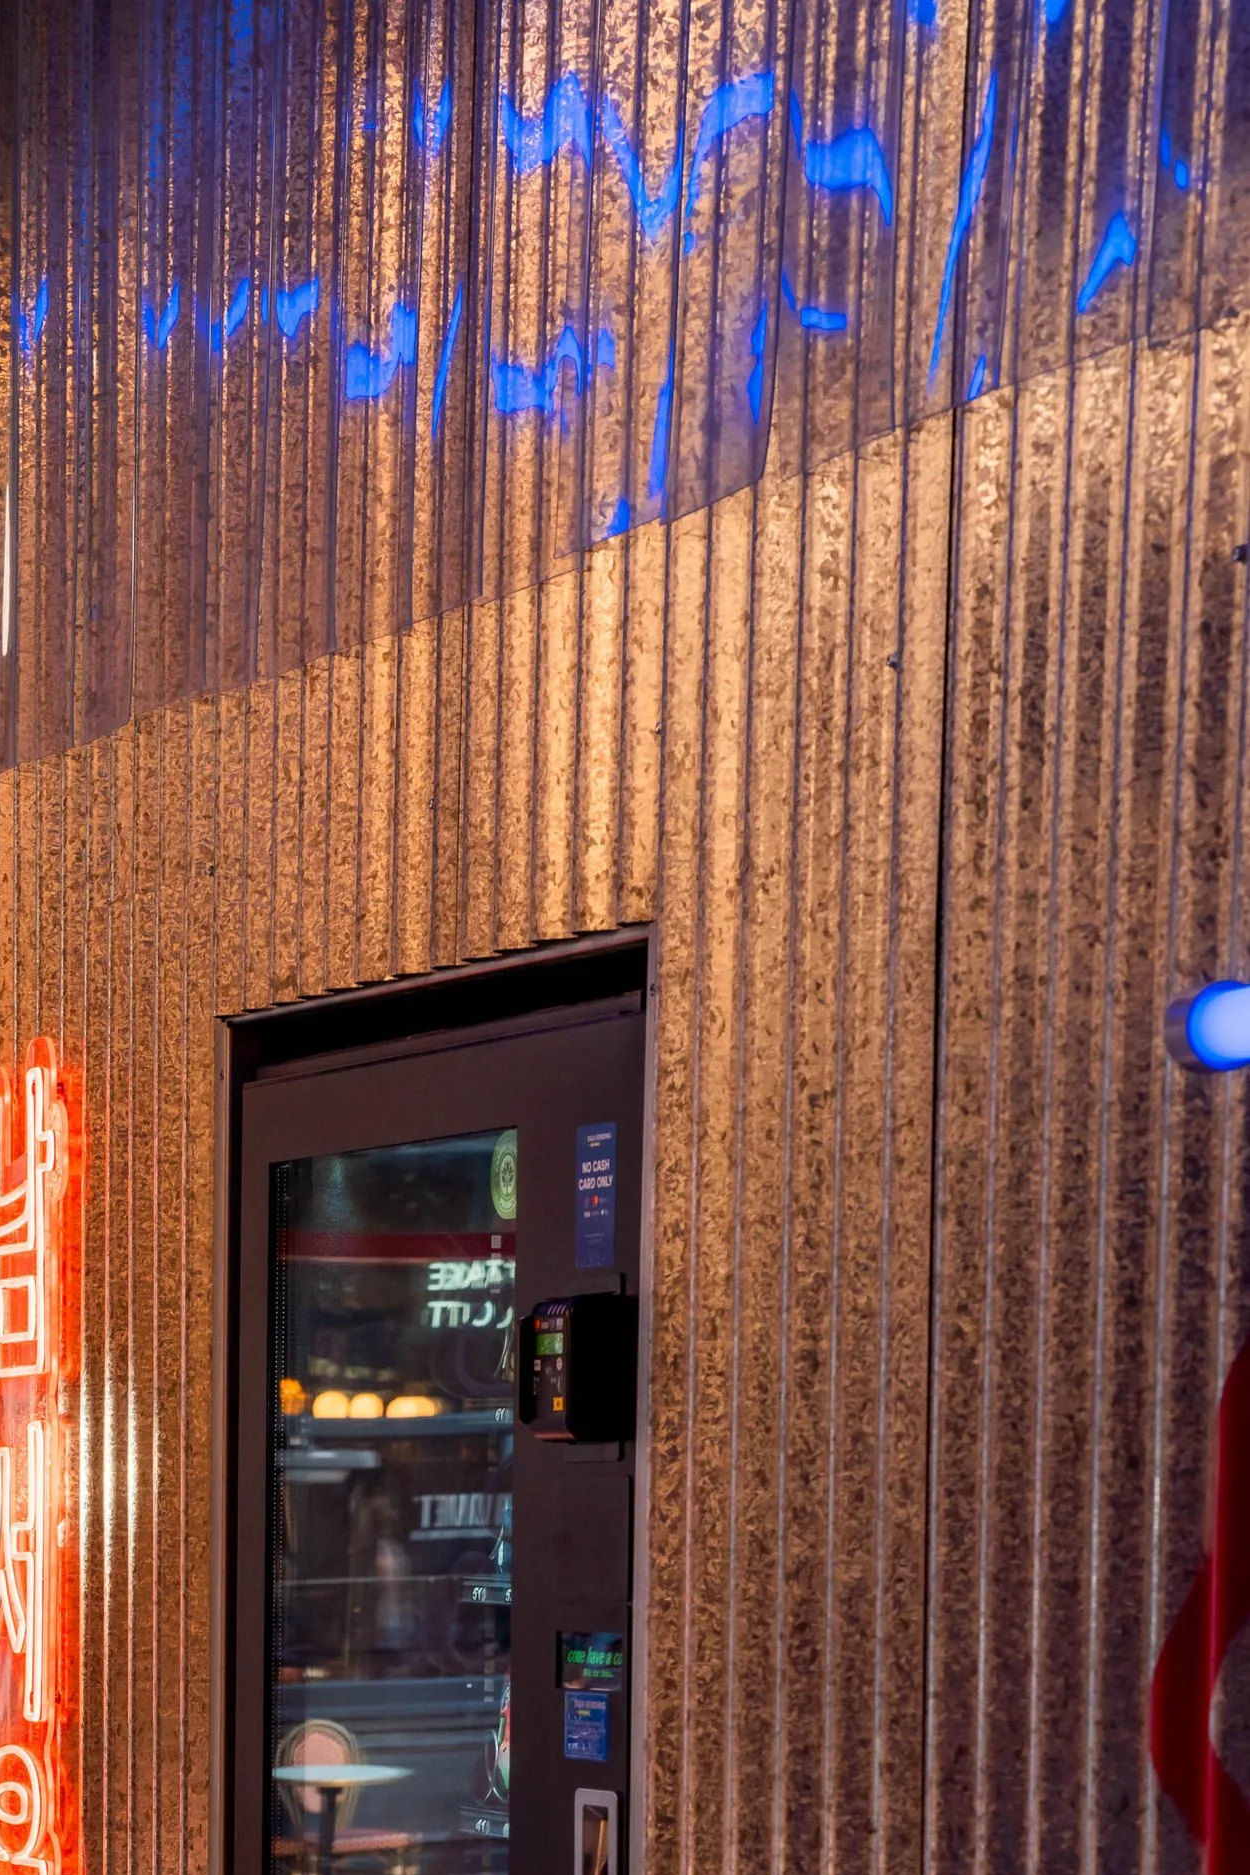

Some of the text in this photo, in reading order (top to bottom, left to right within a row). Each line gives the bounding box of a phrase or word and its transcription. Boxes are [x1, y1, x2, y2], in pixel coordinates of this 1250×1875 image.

[581, 1158, 611, 1175] NO CASH
[578, 1174, 614, 1192] CARD ONLY
[504, 1588, 512, 1602] 5
